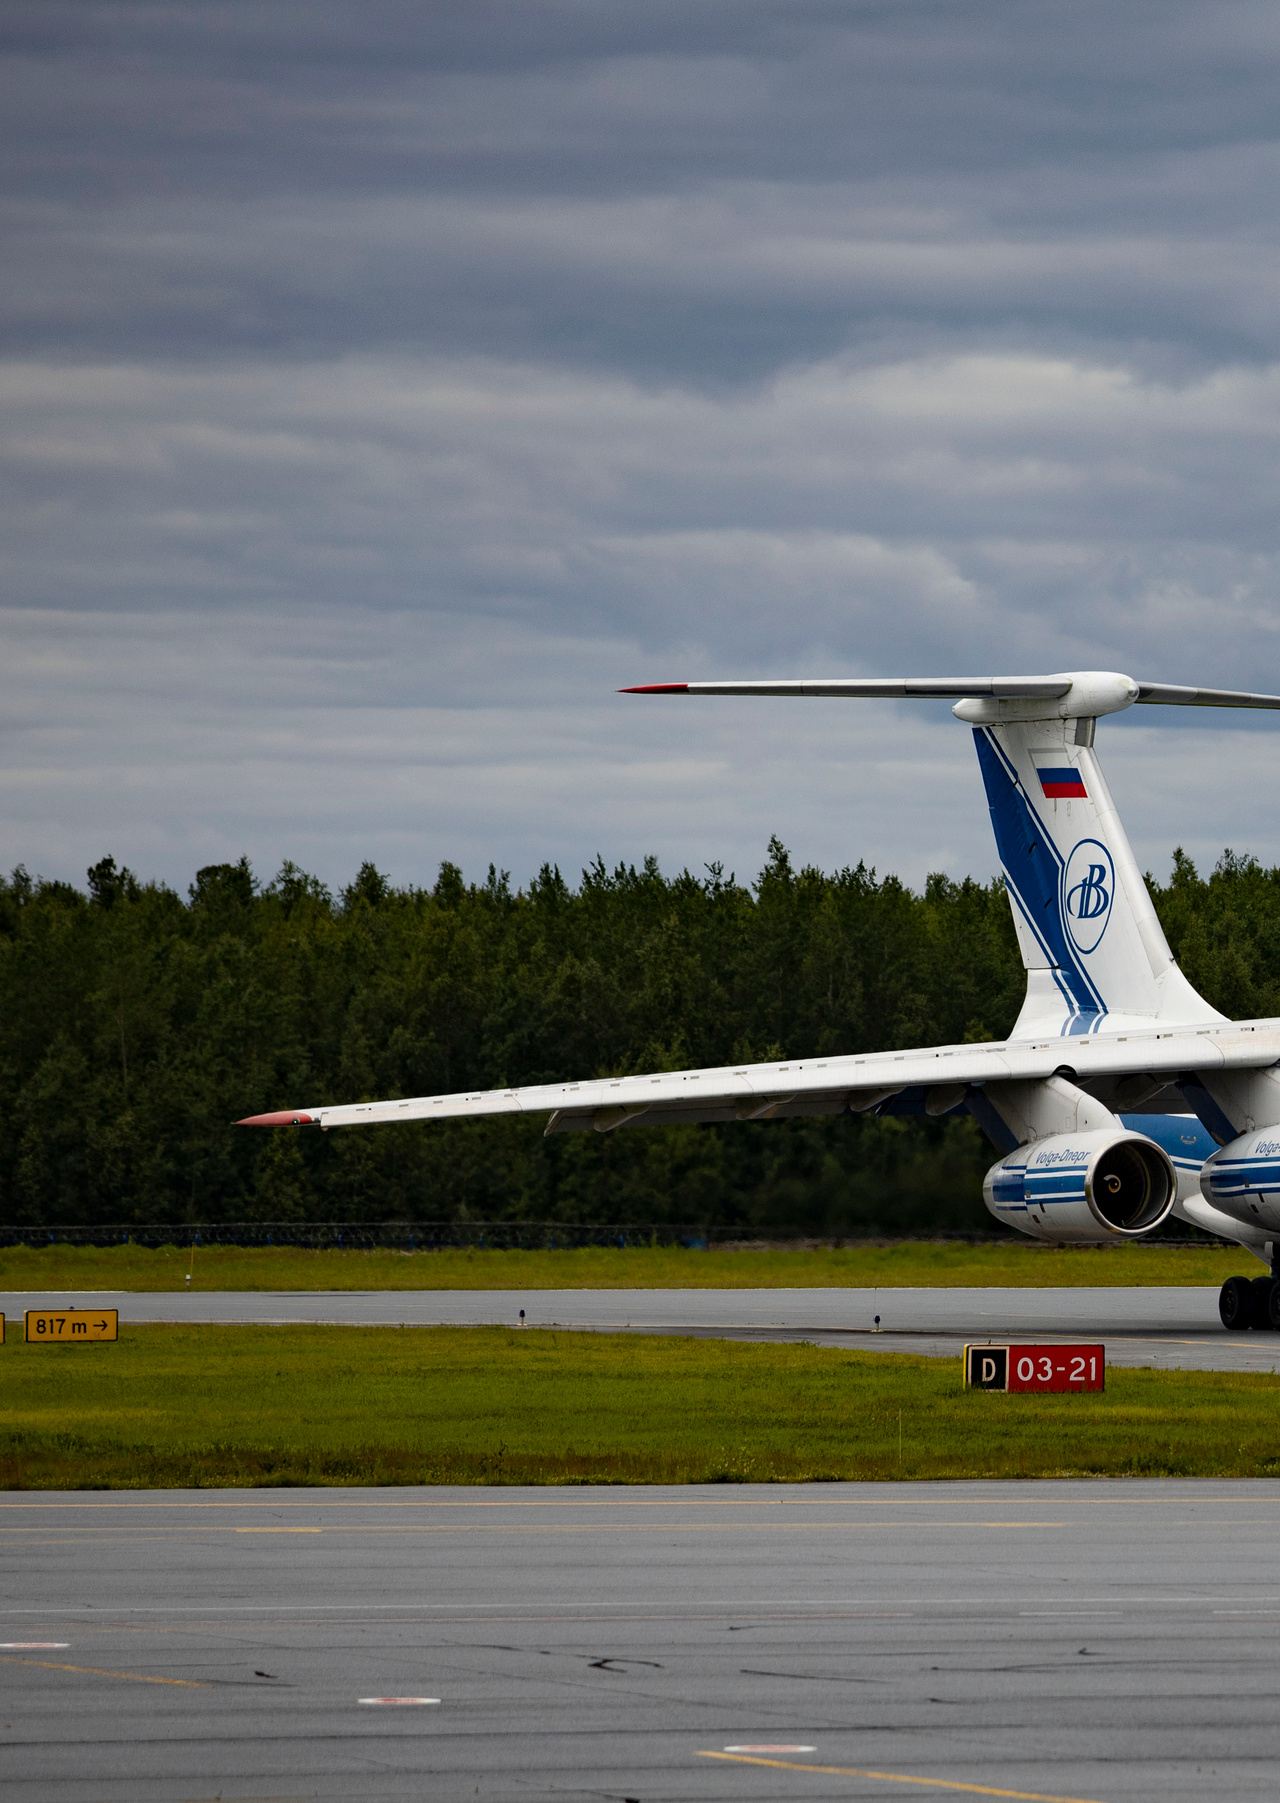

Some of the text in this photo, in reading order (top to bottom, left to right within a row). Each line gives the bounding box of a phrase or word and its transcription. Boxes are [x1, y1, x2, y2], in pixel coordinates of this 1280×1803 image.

[1035, 1148, 1091, 1166] Volga-Dnepr
[36, 1318, 87, 1334] 817 m
[981, 1356, 1097, 1382] D 03-21
